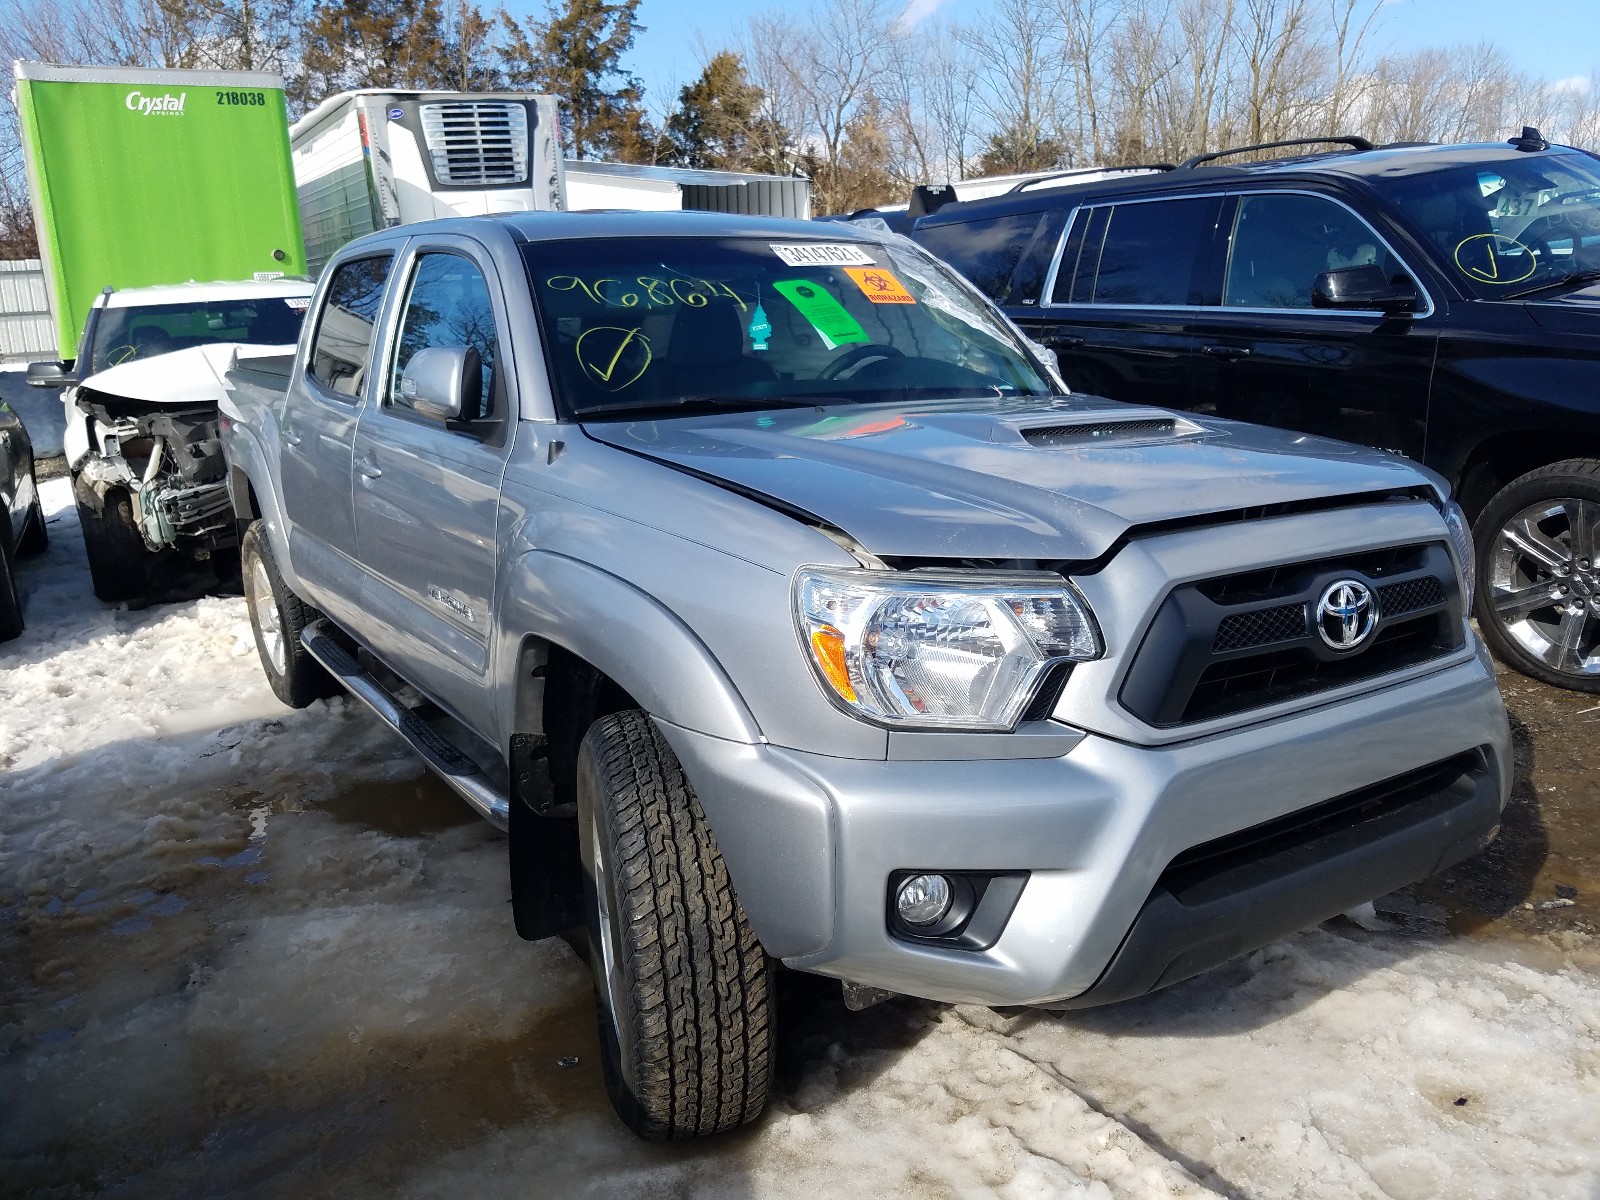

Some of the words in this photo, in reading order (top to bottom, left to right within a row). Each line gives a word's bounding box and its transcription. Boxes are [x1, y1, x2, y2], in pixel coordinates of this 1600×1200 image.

[125, 91, 186, 115] Crystal
[216, 91, 265, 106] 218038
[1500, 198, 1535, 216] 437
[783, 246, 860, 262] 34147621
[868, 294, 914, 302] BIOHAZARD
